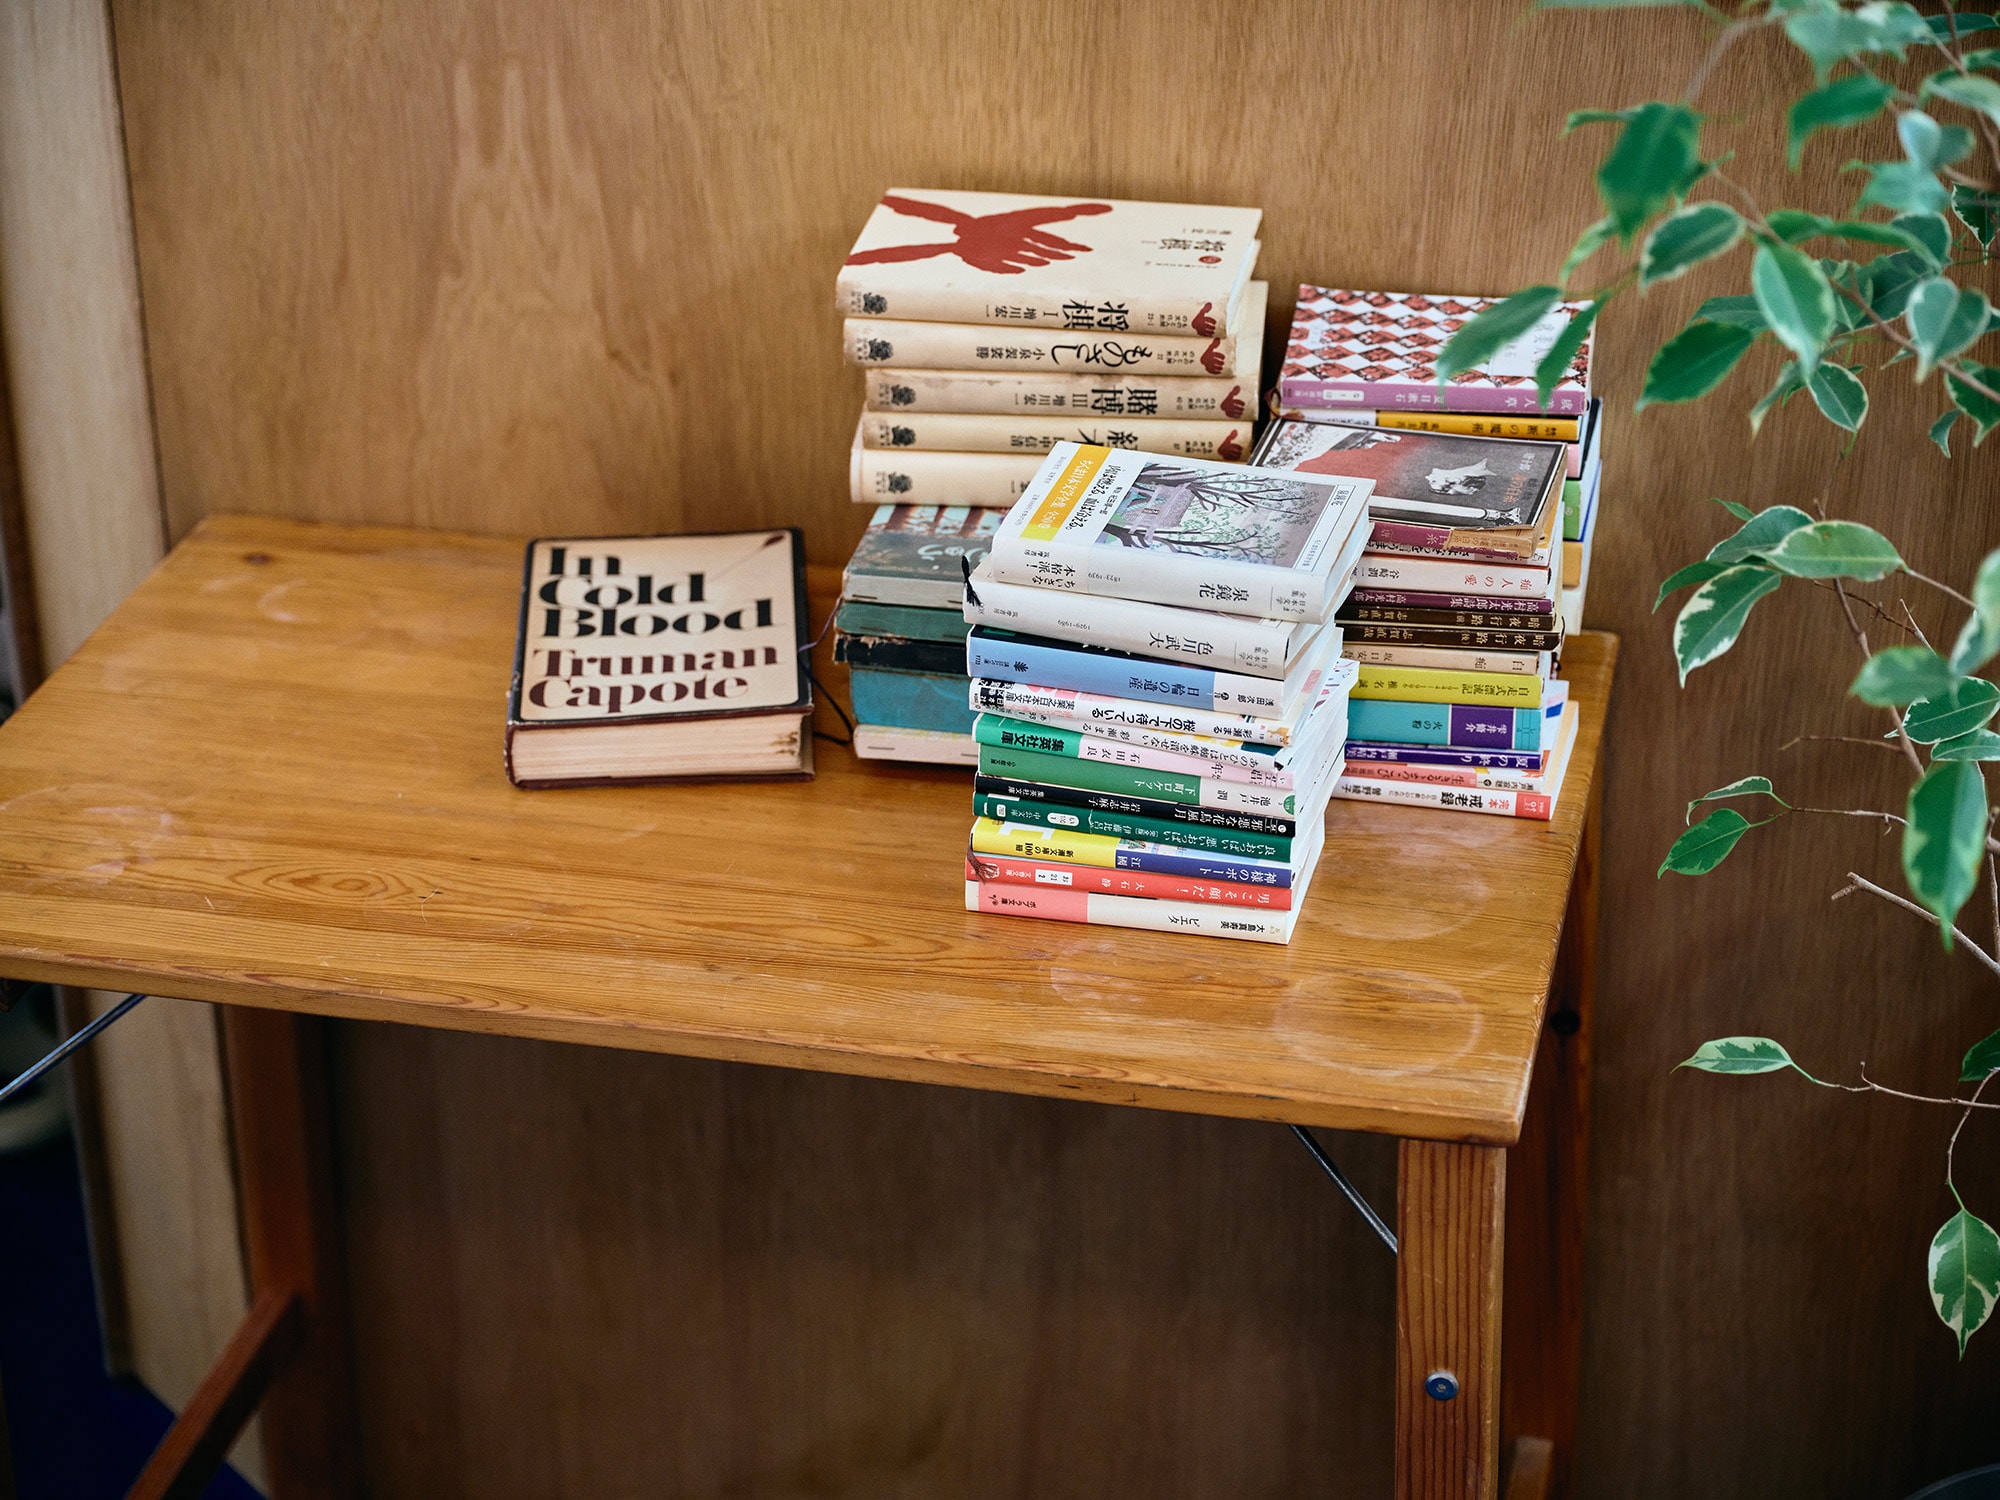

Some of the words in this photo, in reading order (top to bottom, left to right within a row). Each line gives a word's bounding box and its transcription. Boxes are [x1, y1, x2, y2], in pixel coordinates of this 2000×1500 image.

[984, 304, 1037, 319] 増川宏一
[1062, 299, 1129, 331] 将棋
[976, 346, 1045, 360] 小泉袈裟勝
[1051, 342, 1152, 368] ものさし
[1014, 393, 1065, 406] 増川宏一
[1090, 386, 1157, 415] 賭博
[1471, 422, 1557, 440] 禁断の魔術
[1050, 458, 1094, 508] ちくま日本文学全集
[1330, 489, 1350, 507] 泉鏡花
[548, 547, 623, 577] In
[1026, 561, 1076, 577] 本格派！
[538, 572, 709, 607] Cold
[1031, 575, 1076, 589] ちいさな
[1463, 574, 1532, 591] 痴人の愛
[1199, 582, 1249, 602] 泉鏡花
[1291, 590, 1307, 599] 全集
[1354, 590, 1407, 604] 高村光太郎
[1275, 596, 1306, 606] 日本文学
[1450, 596, 1539, 612] 高村光太郎詩集
[1283, 606, 1305, 614] ちくま
[1357, 609, 1408, 621] 志賀直哉
[536, 599, 777, 638] Blood
[1363, 626, 1414, 639] 志賀直哉
[1149, 632, 1214, 655] 色川武大
[1254, 646, 1270, 655] 全集
[533, 645, 781, 678] Truman
[1238, 652, 1269, 663] 日本文学
[1128, 676, 1200, 697] 日輪の遺産
[1461, 683, 1530, 697] 自走式漂流記
[528, 675, 751, 714] Capote
[1006, 691, 1075, 710] 実業之日本社文庫
[1237, 694, 1274, 706] 浅田次郎
[1091, 707, 1196, 733] 桜の下で待っている
[1411, 720, 1443, 731] 火の粉
[1082, 723, 1129, 741] 彩瀬まる
[1213, 726, 1252, 738] 彩瀬まる
[1465, 722, 1507, 736] 雫井脩介
[1001, 731, 1064, 752] 集英社文庫
[1087, 746, 1141, 763] 石田衣良
[1142, 735, 1259, 769] あのひとは蜘蛛を潰せない
[1459, 754, 1529, 768] 夏の終り
[1008, 785, 1044, 798] 集英社文庫
[1134, 780, 1196, 796] 下町ロケット
[1217, 790, 1227, 801] 潤
[1088, 797, 1141, 812] 岩井志麻子
[1239, 793, 1270, 807] 池井戸
[1439, 792, 1483, 810] 戒老録
[1489, 799, 1510, 810] 完本
[1011, 809, 1041, 820] 中公文庫
[1174, 808, 1263, 832] 邪悪な花鳥風月
[1163, 830, 1216, 847] 悪いおっぱい
[1015, 842, 1074, 858] 新潮文庫の100冊
[1221, 839, 1275, 856] 良いおっぱい
[1117, 856, 1141, 868] 江國
[1005, 869, 1031, 878] 文春文庫
[1199, 867, 1277, 884] 神様のボート
[1101, 878, 1112, 888] 静
[1121, 880, 1145, 891] 大石
[1177, 885, 1270, 904] 男こそ顔だ！
[1001, 897, 1037, 909] ポプラ文庫
[1167, 915, 1199, 928] ピエタ
[1219, 921, 1264, 934] 大島真寿美
